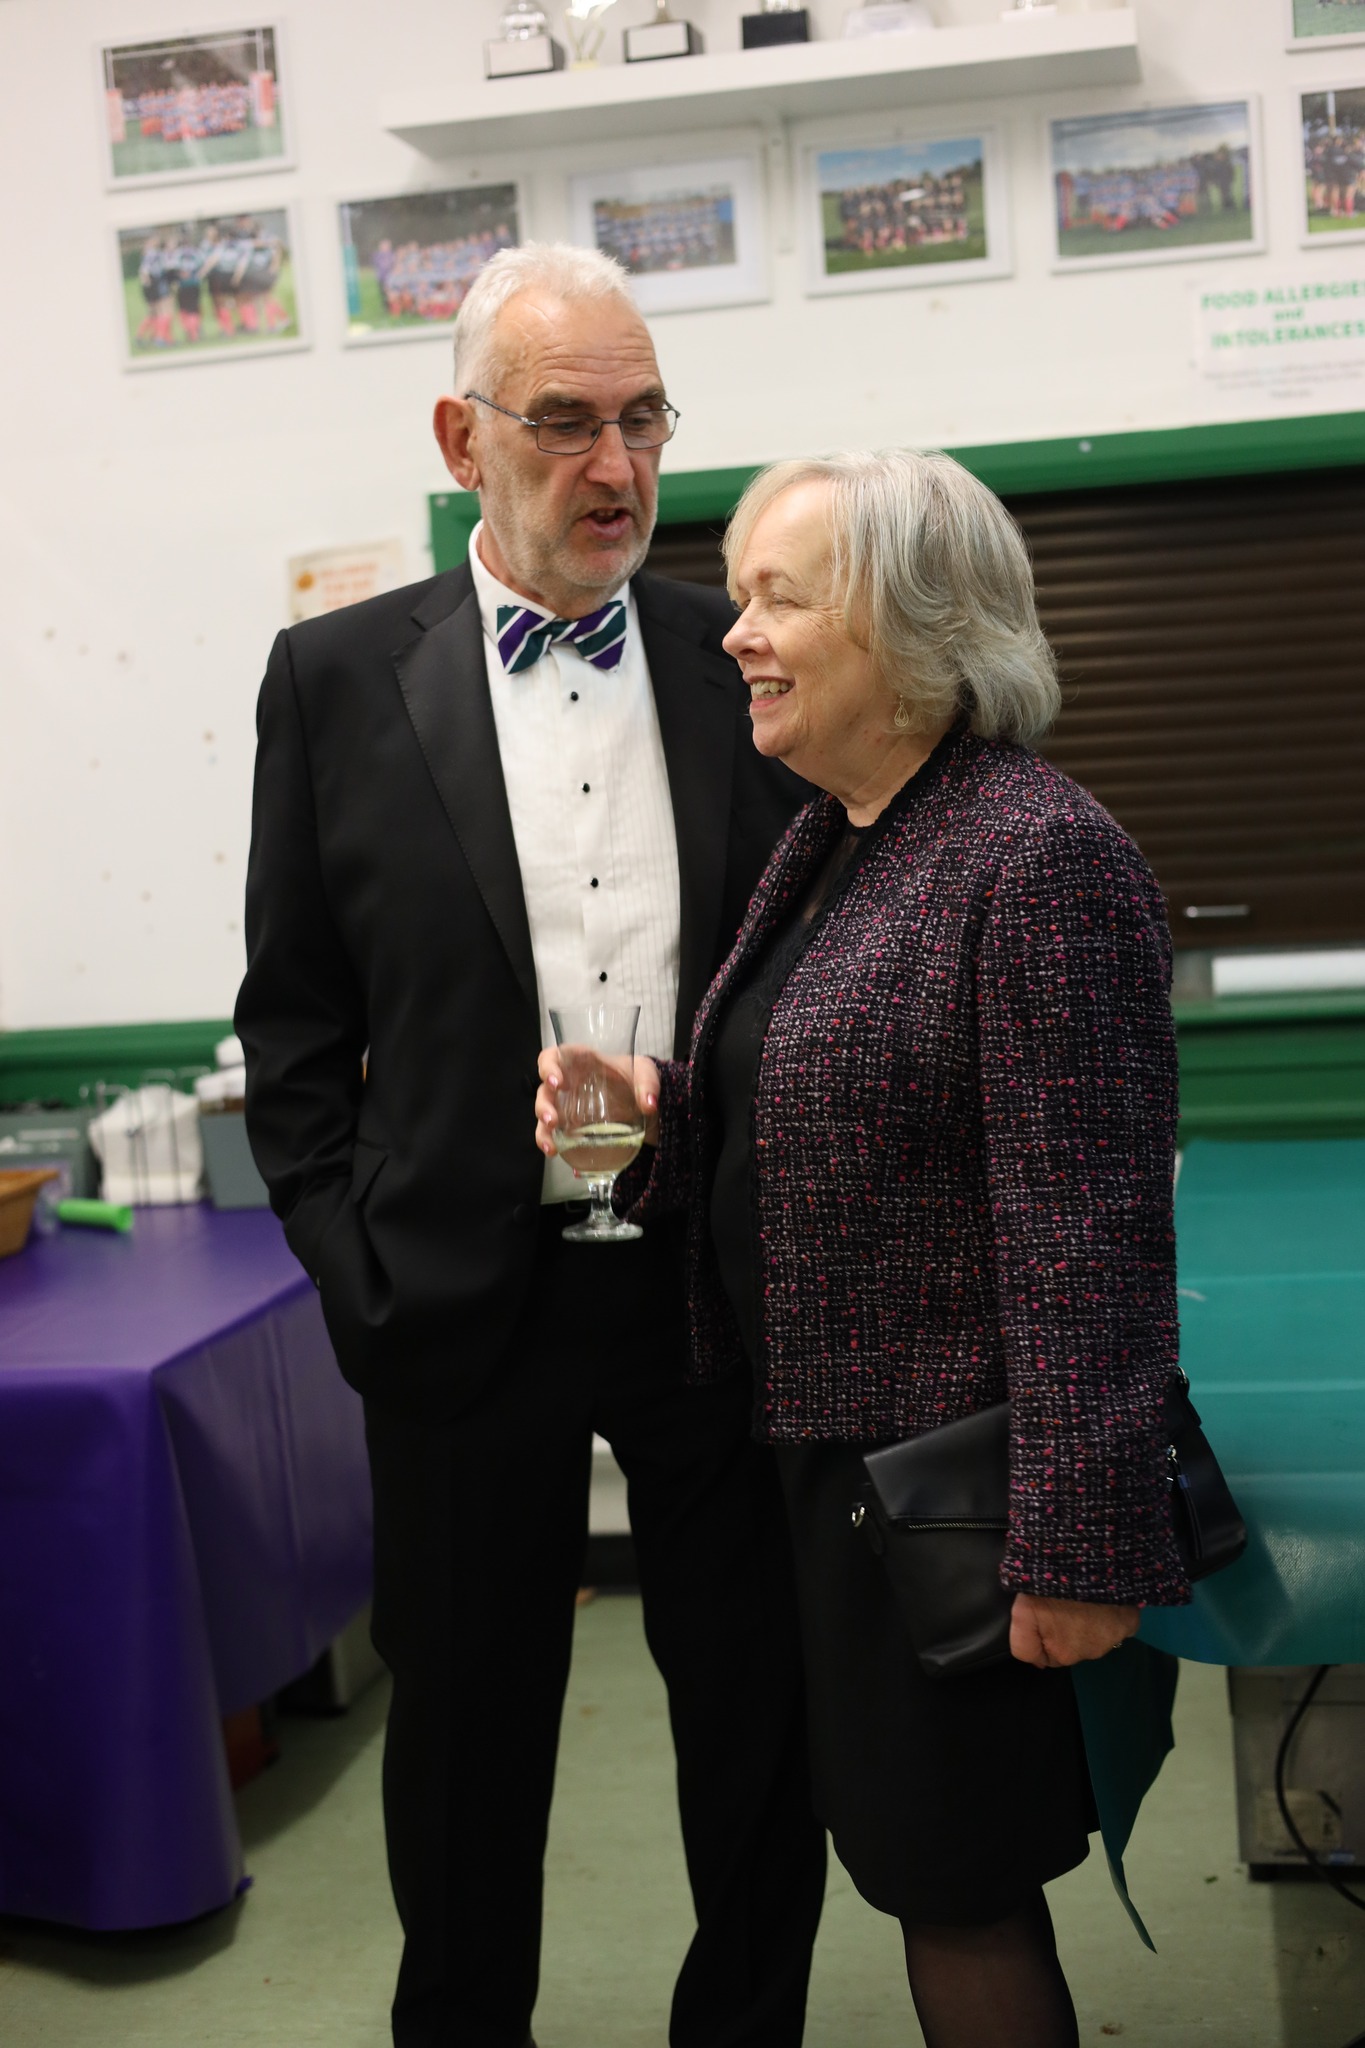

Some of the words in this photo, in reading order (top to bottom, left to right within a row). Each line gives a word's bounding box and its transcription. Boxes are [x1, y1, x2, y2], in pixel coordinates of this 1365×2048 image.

[1201, 289, 1257, 310] FOOD
[1265, 281, 1365, 304] ALLERGIE
[1274, 306, 1304, 321] and
[1211, 320, 1365, 348] INTOLERANCES
